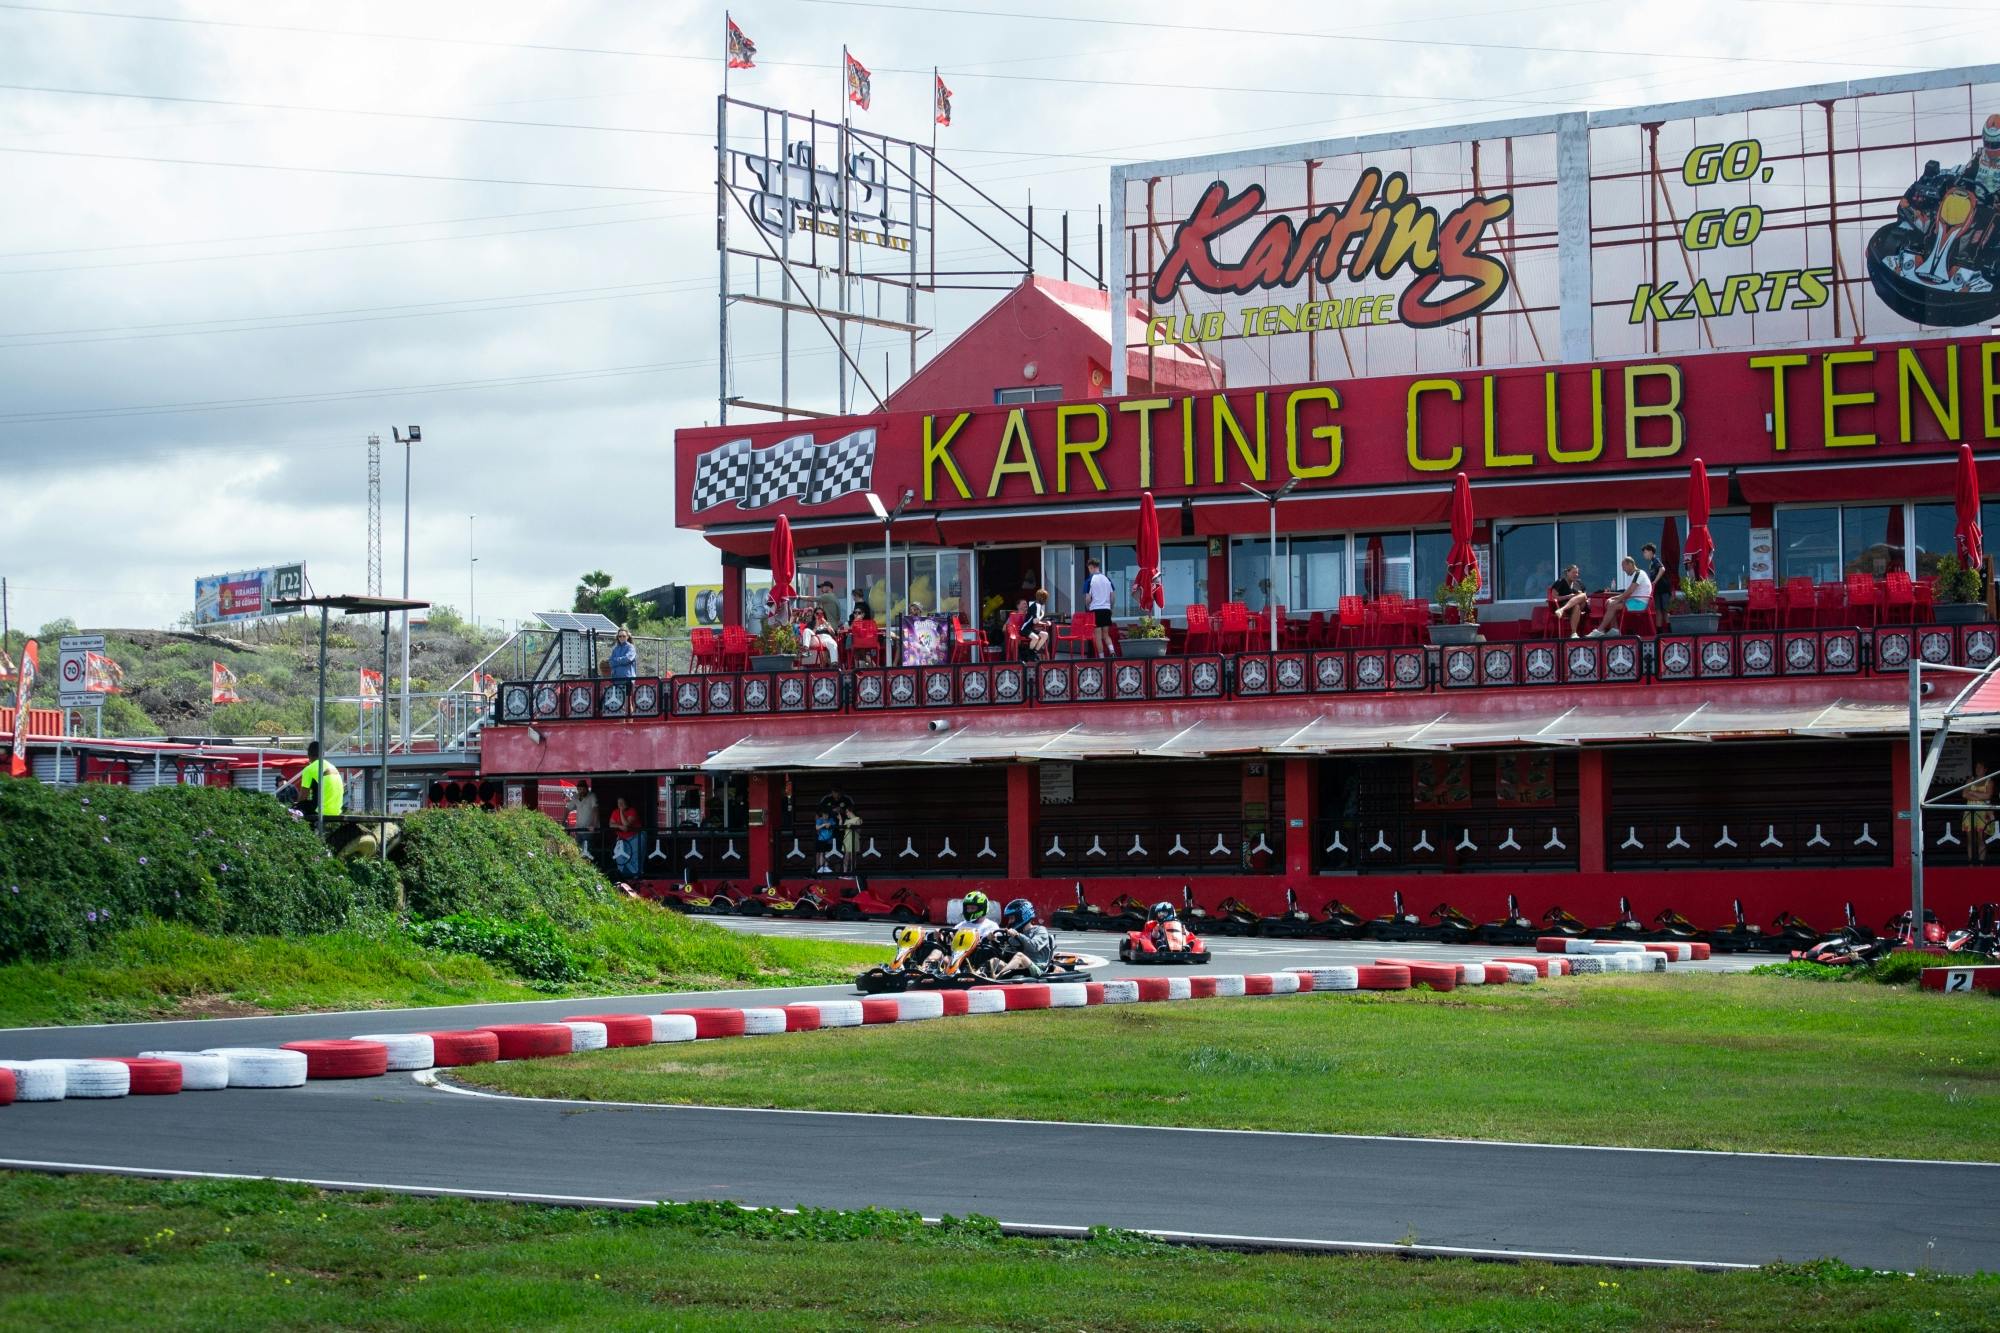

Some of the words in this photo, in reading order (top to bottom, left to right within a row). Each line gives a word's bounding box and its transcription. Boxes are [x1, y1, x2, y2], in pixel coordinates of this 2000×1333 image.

[1683, 138, 1774, 187] GO,
[1151, 166, 1513, 329] Karting
[1682, 205, 1764, 252] GO
[1628, 267, 1833, 324] KARTS
[1145, 310, 1226, 347] CLUB
[1239, 293, 1396, 339] TENERIFE
[921, 387, 1345, 502] KARTING
[1406, 364, 1686, 472] CLUB
[67, 666, 77, 675] 70
[902, 931, 911, 943] 4
[959, 933, 966, 946] 1
[1952, 973, 1967, 991] 2
